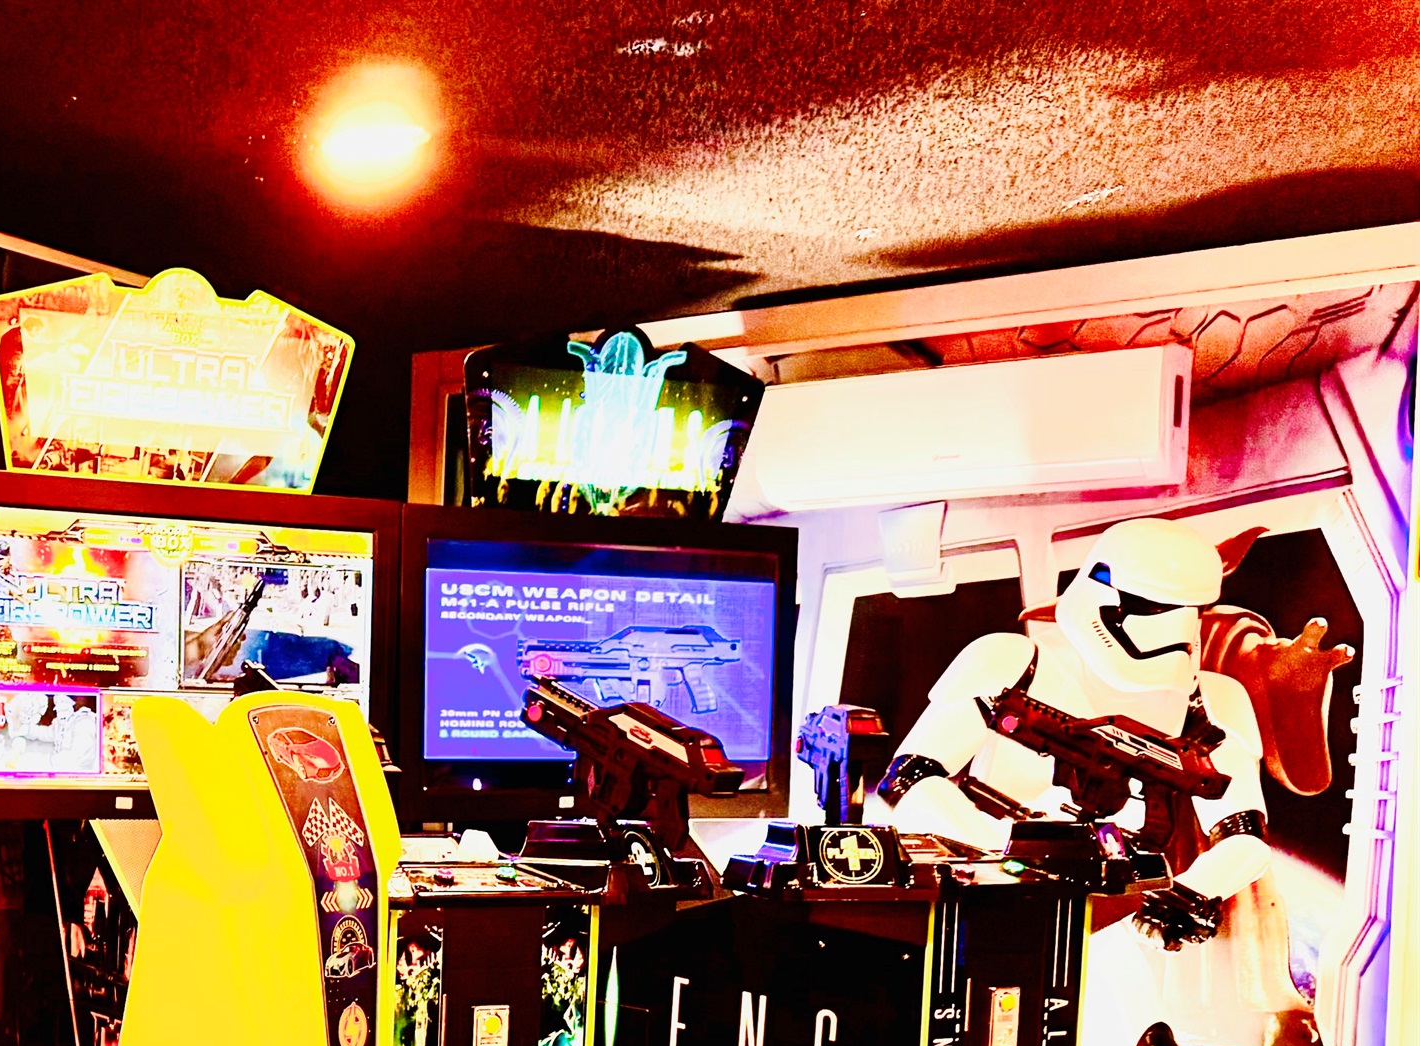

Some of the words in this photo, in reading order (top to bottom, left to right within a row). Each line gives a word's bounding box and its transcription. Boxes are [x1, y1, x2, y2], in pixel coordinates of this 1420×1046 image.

[120, 347, 246, 390] ULTRA
[440, 583, 513, 597] USCM
[522, 586, 626, 602] WEAPON
[636, 590, 715, 605] DETAIL
[440, 598, 499, 609] M41-A
[506, 600, 561, 610] PULSE
[568, 602, 615, 612] RIFLE
[440, 611, 521, 621] SECONDARY
[334, 865, 355, 878] NO.1
